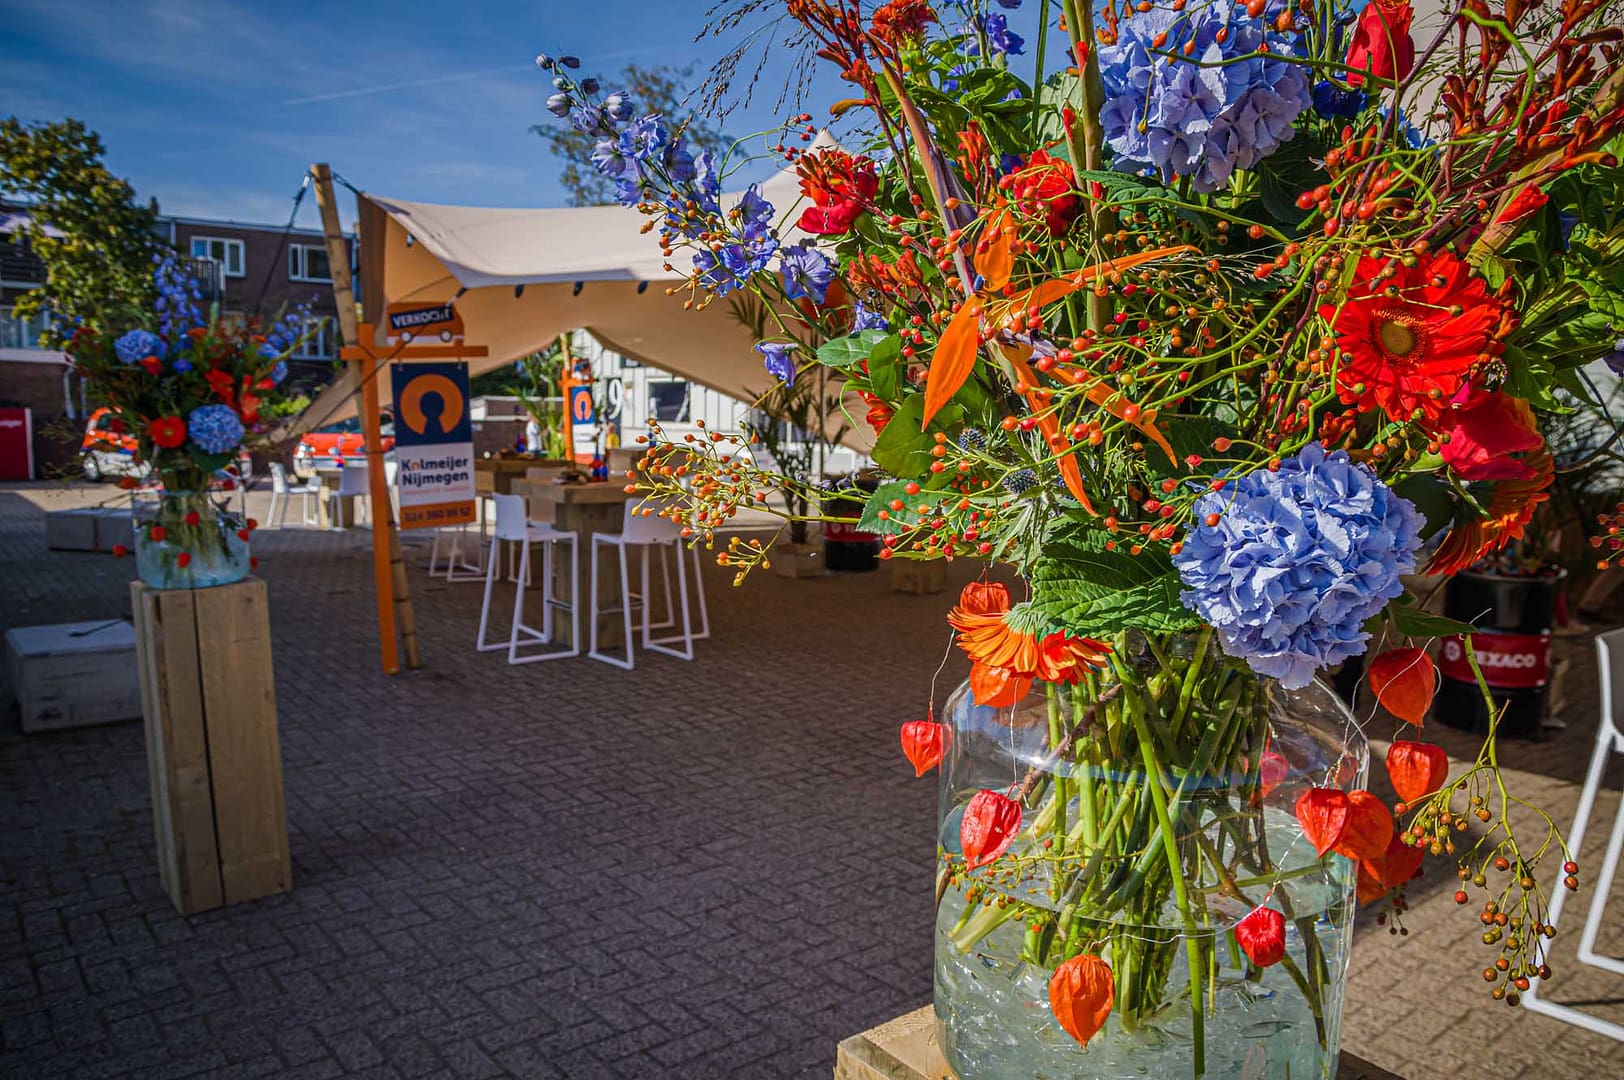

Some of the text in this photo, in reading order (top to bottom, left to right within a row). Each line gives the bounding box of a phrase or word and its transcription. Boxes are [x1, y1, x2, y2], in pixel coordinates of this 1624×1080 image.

[608, 379, 622, 420] 9
[401, 456, 469, 471] Kolmeijer
[402, 472, 469, 487] Nijmegen
